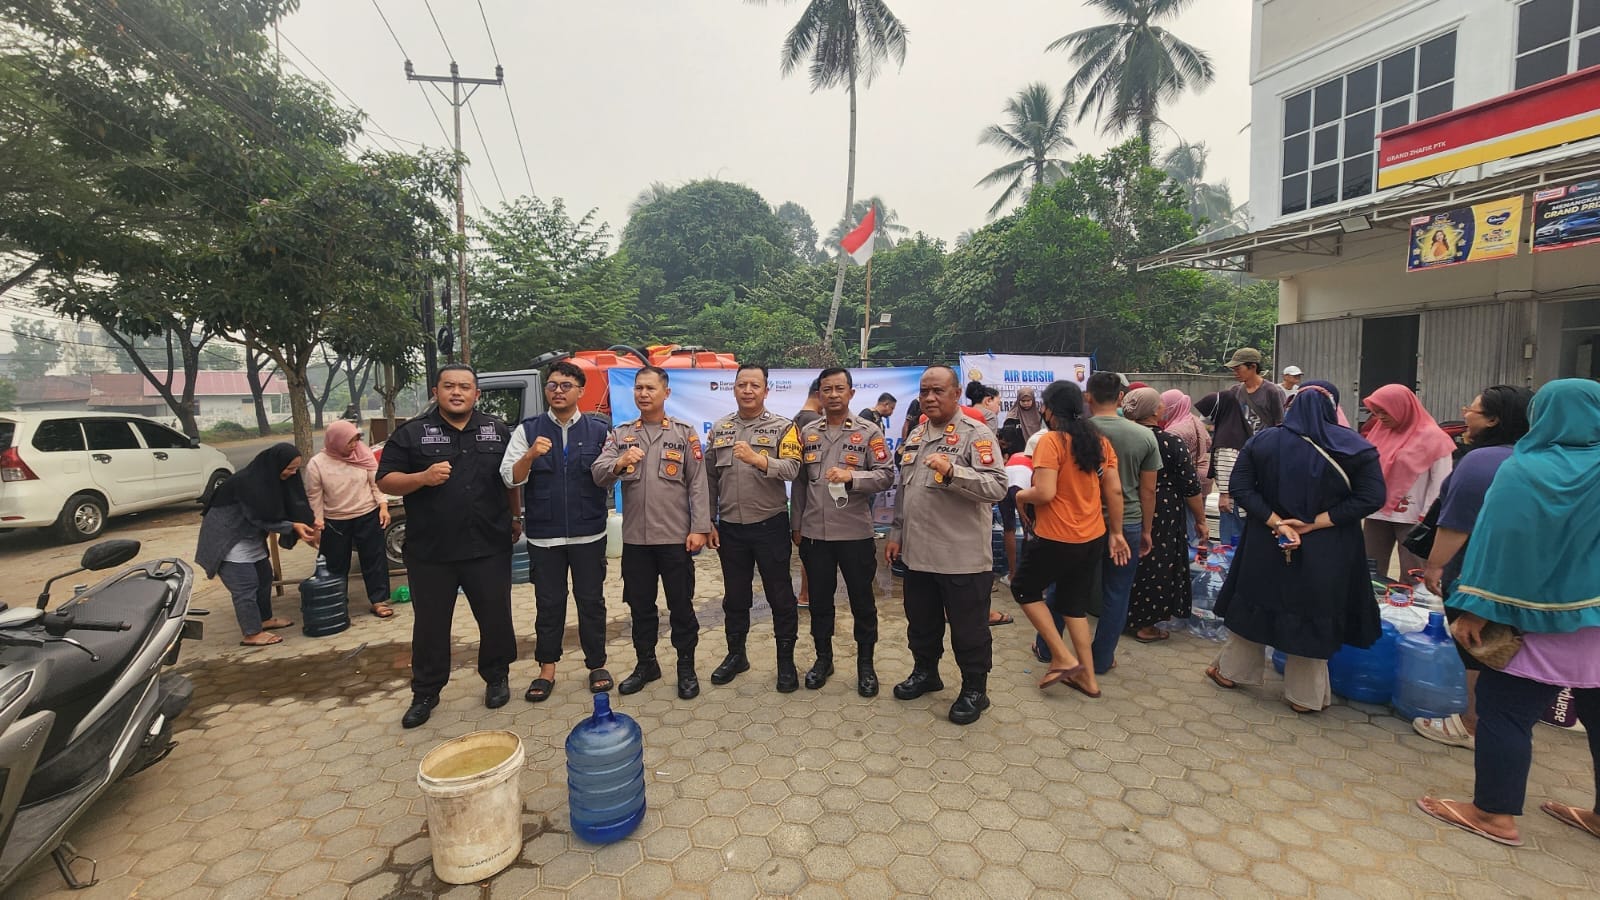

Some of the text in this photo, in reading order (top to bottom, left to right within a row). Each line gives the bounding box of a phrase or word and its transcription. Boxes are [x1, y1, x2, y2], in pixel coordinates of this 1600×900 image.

[1386, 152, 1409, 162] GRAND
[1433, 141, 1447, 150] PTK
[1551, 195, 1600, 210] MENANGKA
[1543, 206, 1579, 219] GRAND
[1004, 369, 1054, 383] AIR BERSIH
[663, 442, 685, 451] POLRI
[843, 444, 866, 453] POLRI
[936, 445, 960, 454] POLRI
